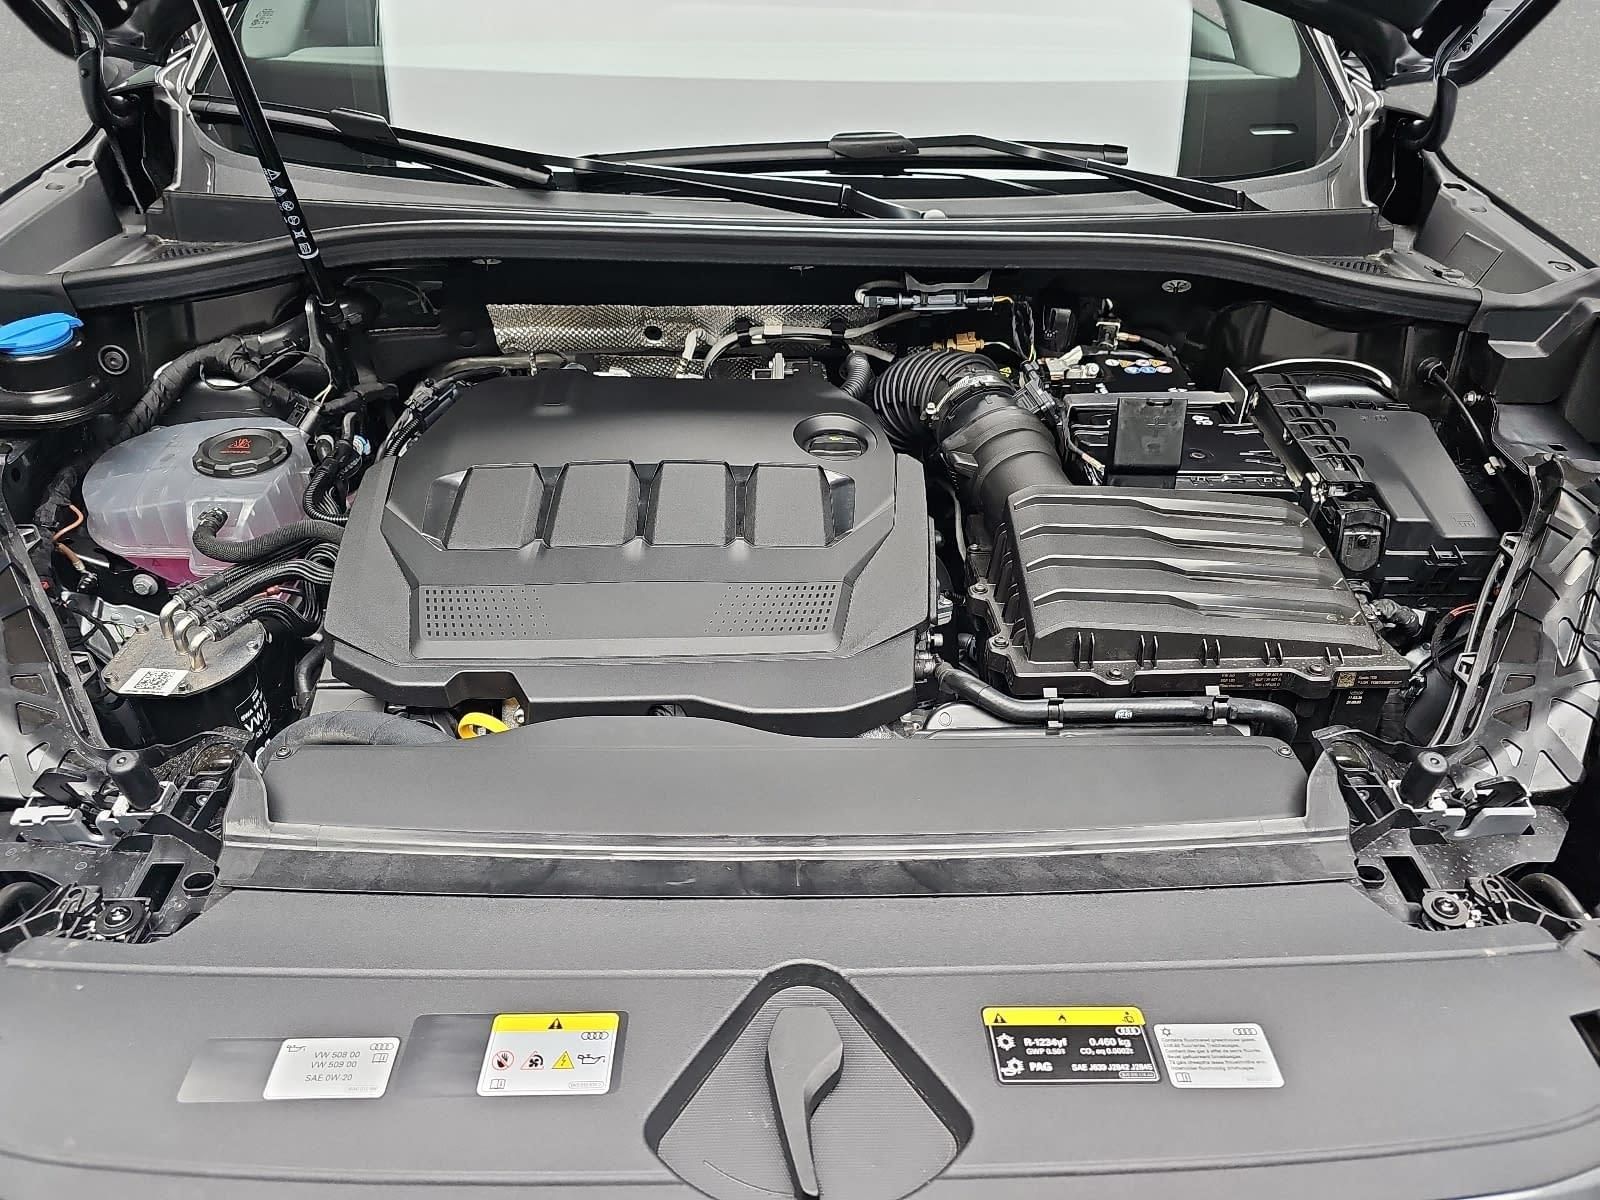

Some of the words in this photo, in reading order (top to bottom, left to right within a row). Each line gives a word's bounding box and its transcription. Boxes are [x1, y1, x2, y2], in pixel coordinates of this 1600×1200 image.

[1117, 1037, 1132, 1048] kg
[314, 1051, 330, 1059] VW
[349, 1051, 361, 1059] 00
[311, 1061, 327, 1069] VW
[1029, 1061, 1053, 1072] PAG
[304, 1074, 324, 1082] SAE
